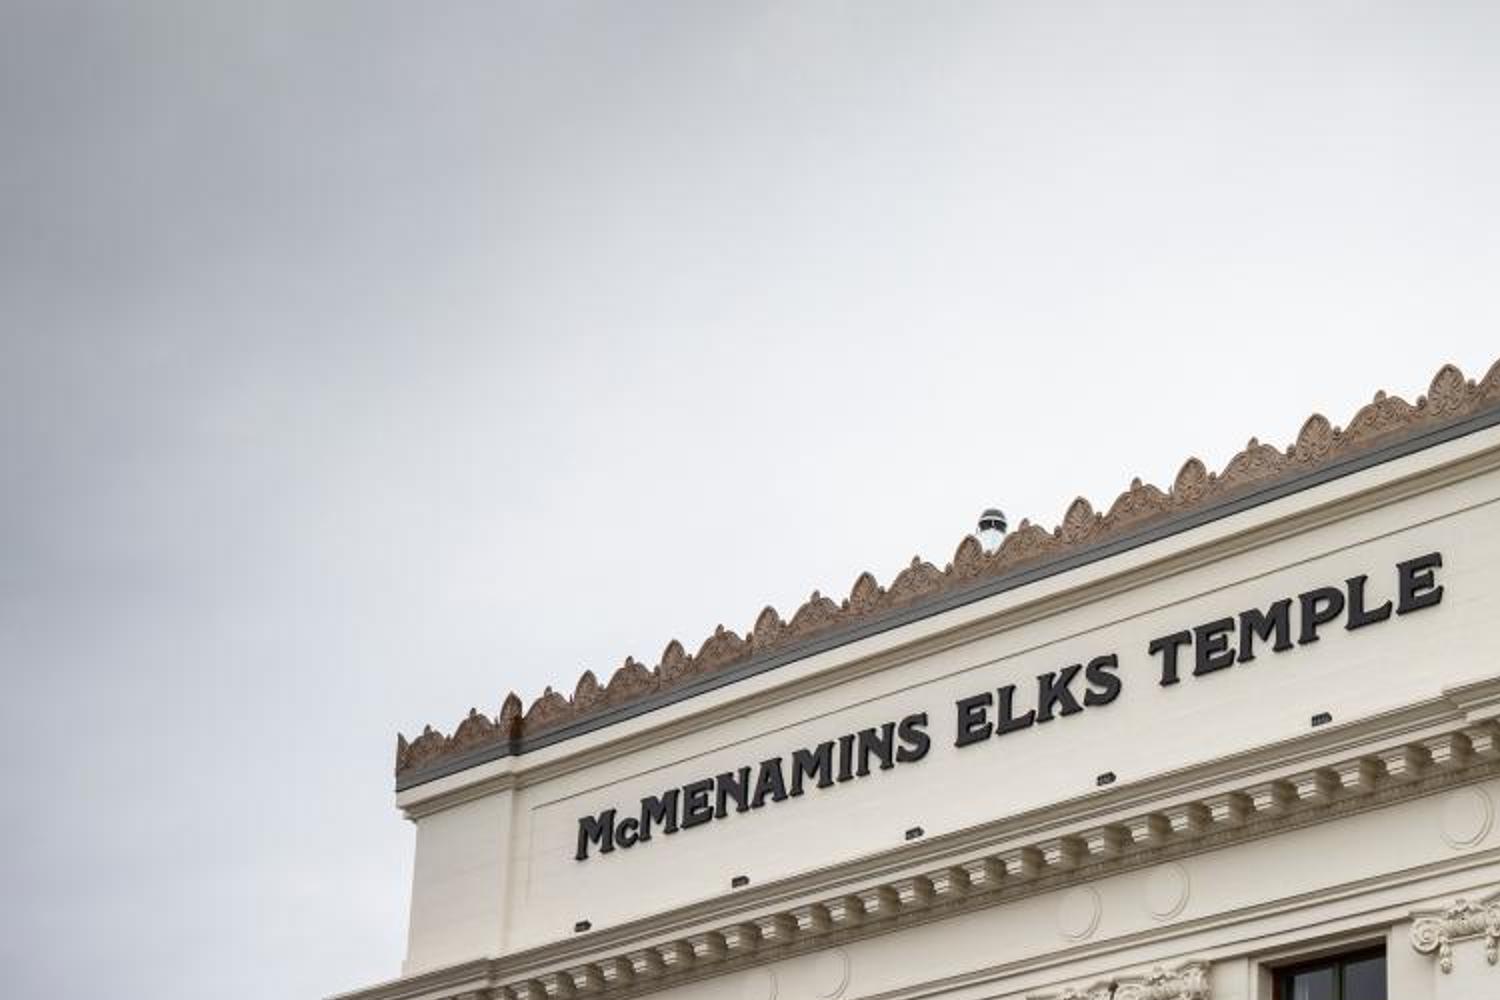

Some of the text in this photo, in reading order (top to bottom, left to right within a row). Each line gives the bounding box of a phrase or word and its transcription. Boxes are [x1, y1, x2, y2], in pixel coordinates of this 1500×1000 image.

[575, 552, 1444, 861] McMENAMINS ELKS TEMPLE
